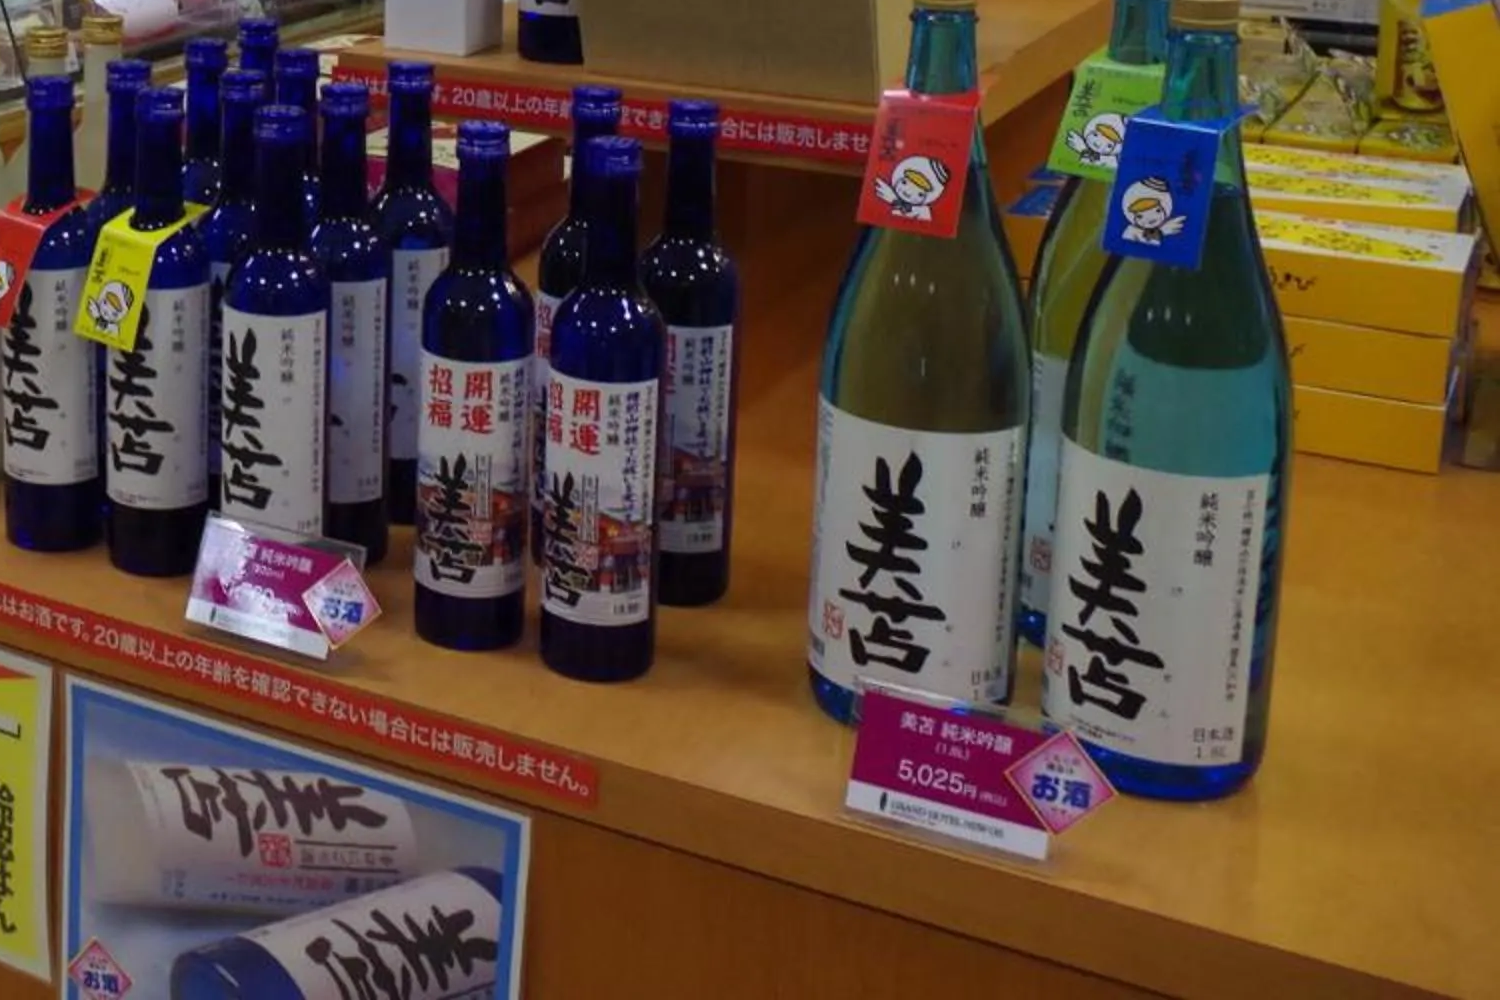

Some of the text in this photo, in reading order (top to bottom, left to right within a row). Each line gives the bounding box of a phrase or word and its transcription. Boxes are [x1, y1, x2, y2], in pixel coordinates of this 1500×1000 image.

[280, 328, 295, 384] 純米吟醸
[222, 328, 283, 510] 美苫
[427, 363, 454, 428] 招福
[462, 370, 494, 435] 開運
[569, 389, 600, 456] 開運
[969, 447, 991, 519] 純米吟醸
[839, 450, 948, 674] 美苫
[1193, 492, 1220, 567] 純米吟醸
[1061, 487, 1165, 721] 美苫
[899, 711, 1015, 756] 美苫 純米吟醸
[896, 758, 978, 799] 5,025円
[1031, 773, 1093, 810] お酒
